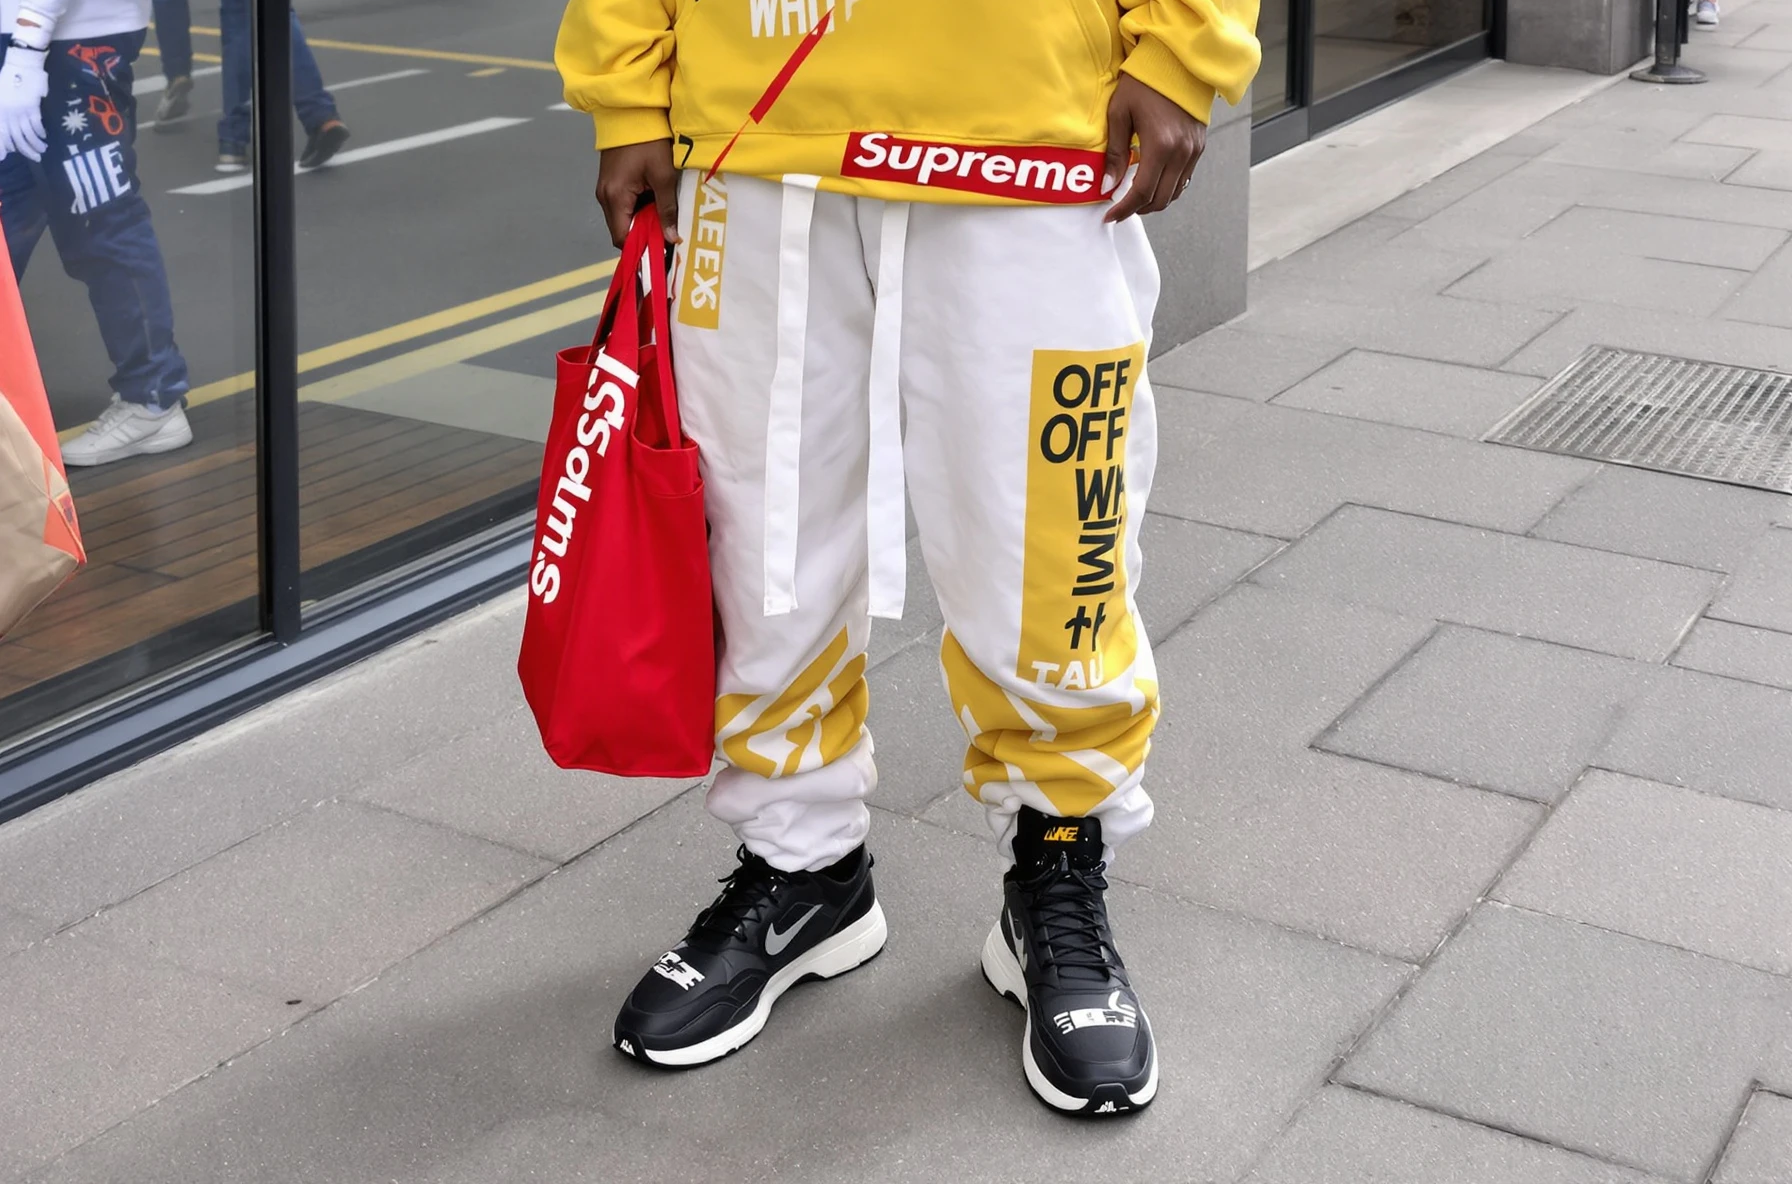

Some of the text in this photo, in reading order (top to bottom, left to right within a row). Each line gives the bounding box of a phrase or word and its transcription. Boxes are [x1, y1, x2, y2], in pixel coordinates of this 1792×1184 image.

[853, 132, 1095, 194] Supreme
[1053, 359, 1131, 409] OFF
[1040, 407, 1125, 464] OFF
